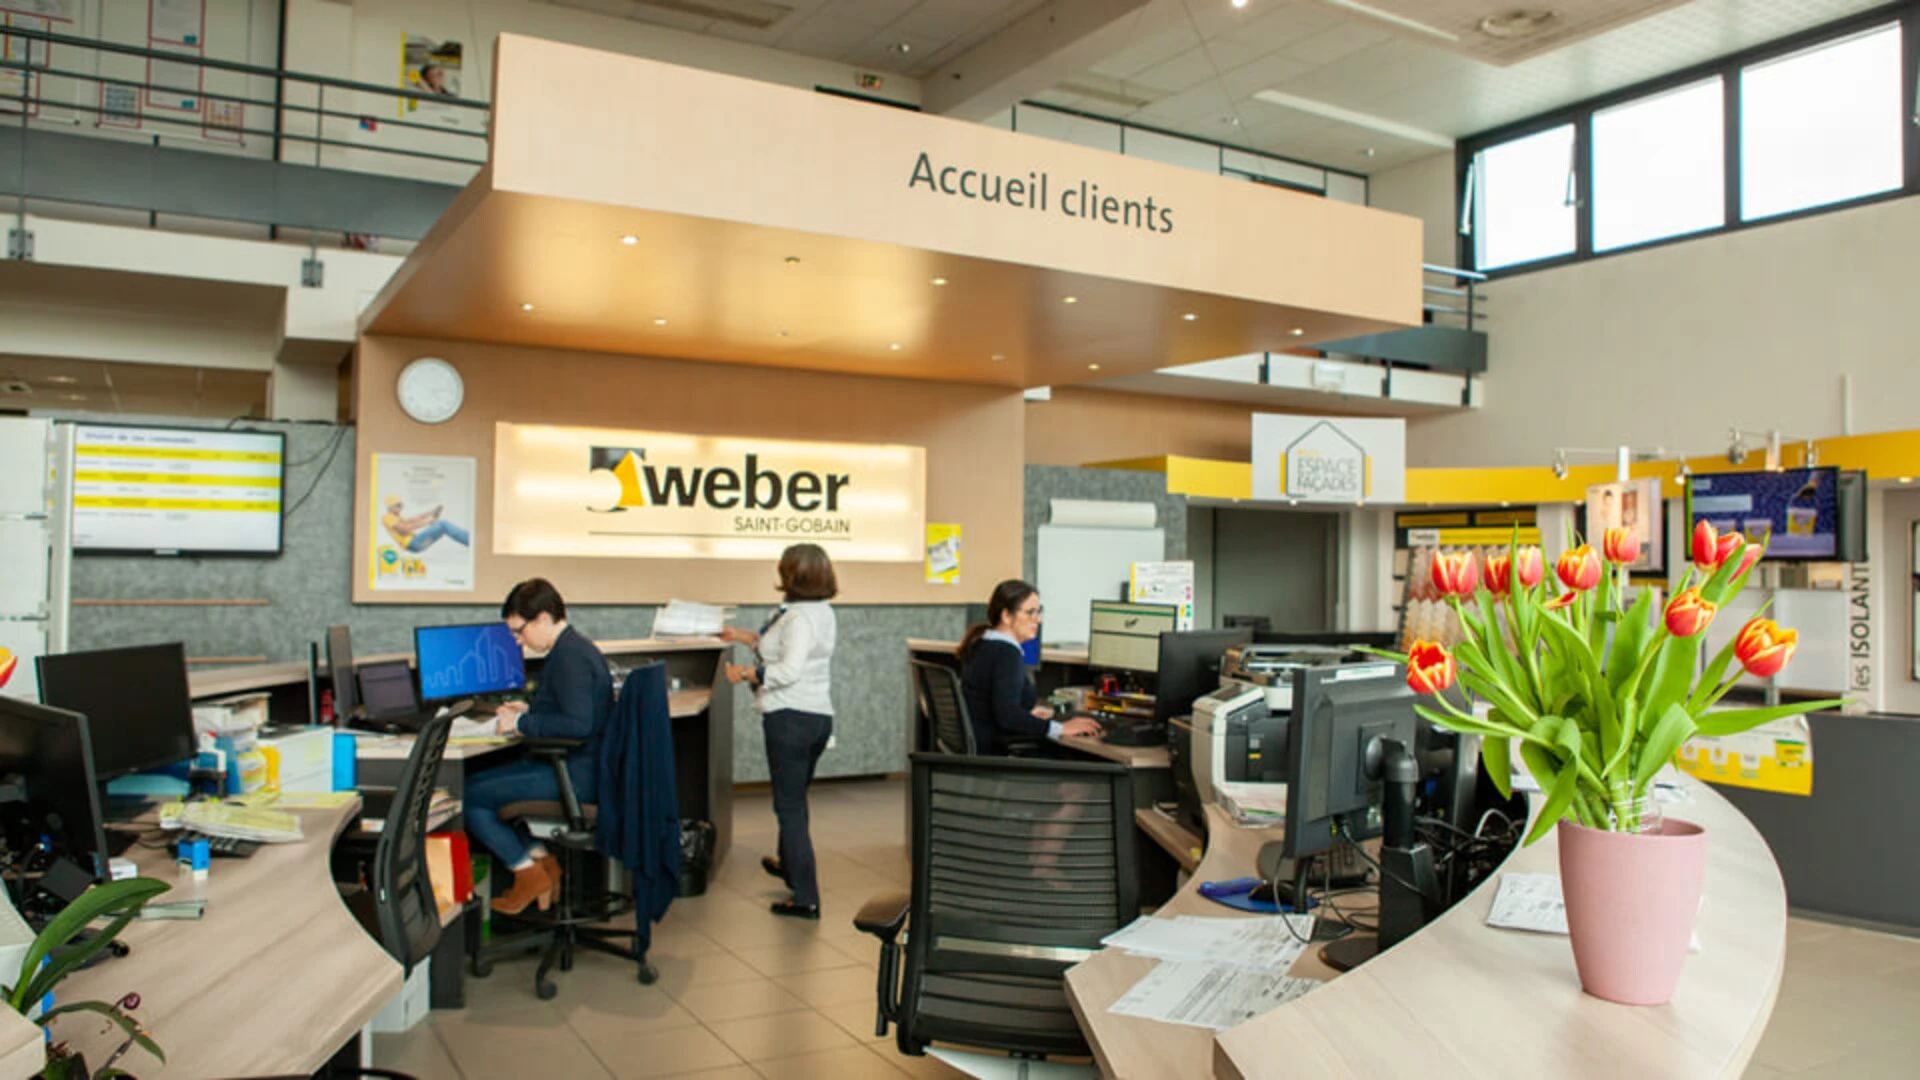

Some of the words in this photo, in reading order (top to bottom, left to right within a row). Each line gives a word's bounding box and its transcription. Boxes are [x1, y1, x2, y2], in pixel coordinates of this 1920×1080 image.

[909, 152, 1047, 211] Accueil
[1060, 180, 1174, 234] clients
[643, 453, 850, 512] weber
[1297, 457, 1357, 474] ESPACE
[734, 515, 850, 533] SAINT-GOBAIN
[1851, 557, 1870, 658] ISOLANT
[1851, 664, 1870, 691] les
